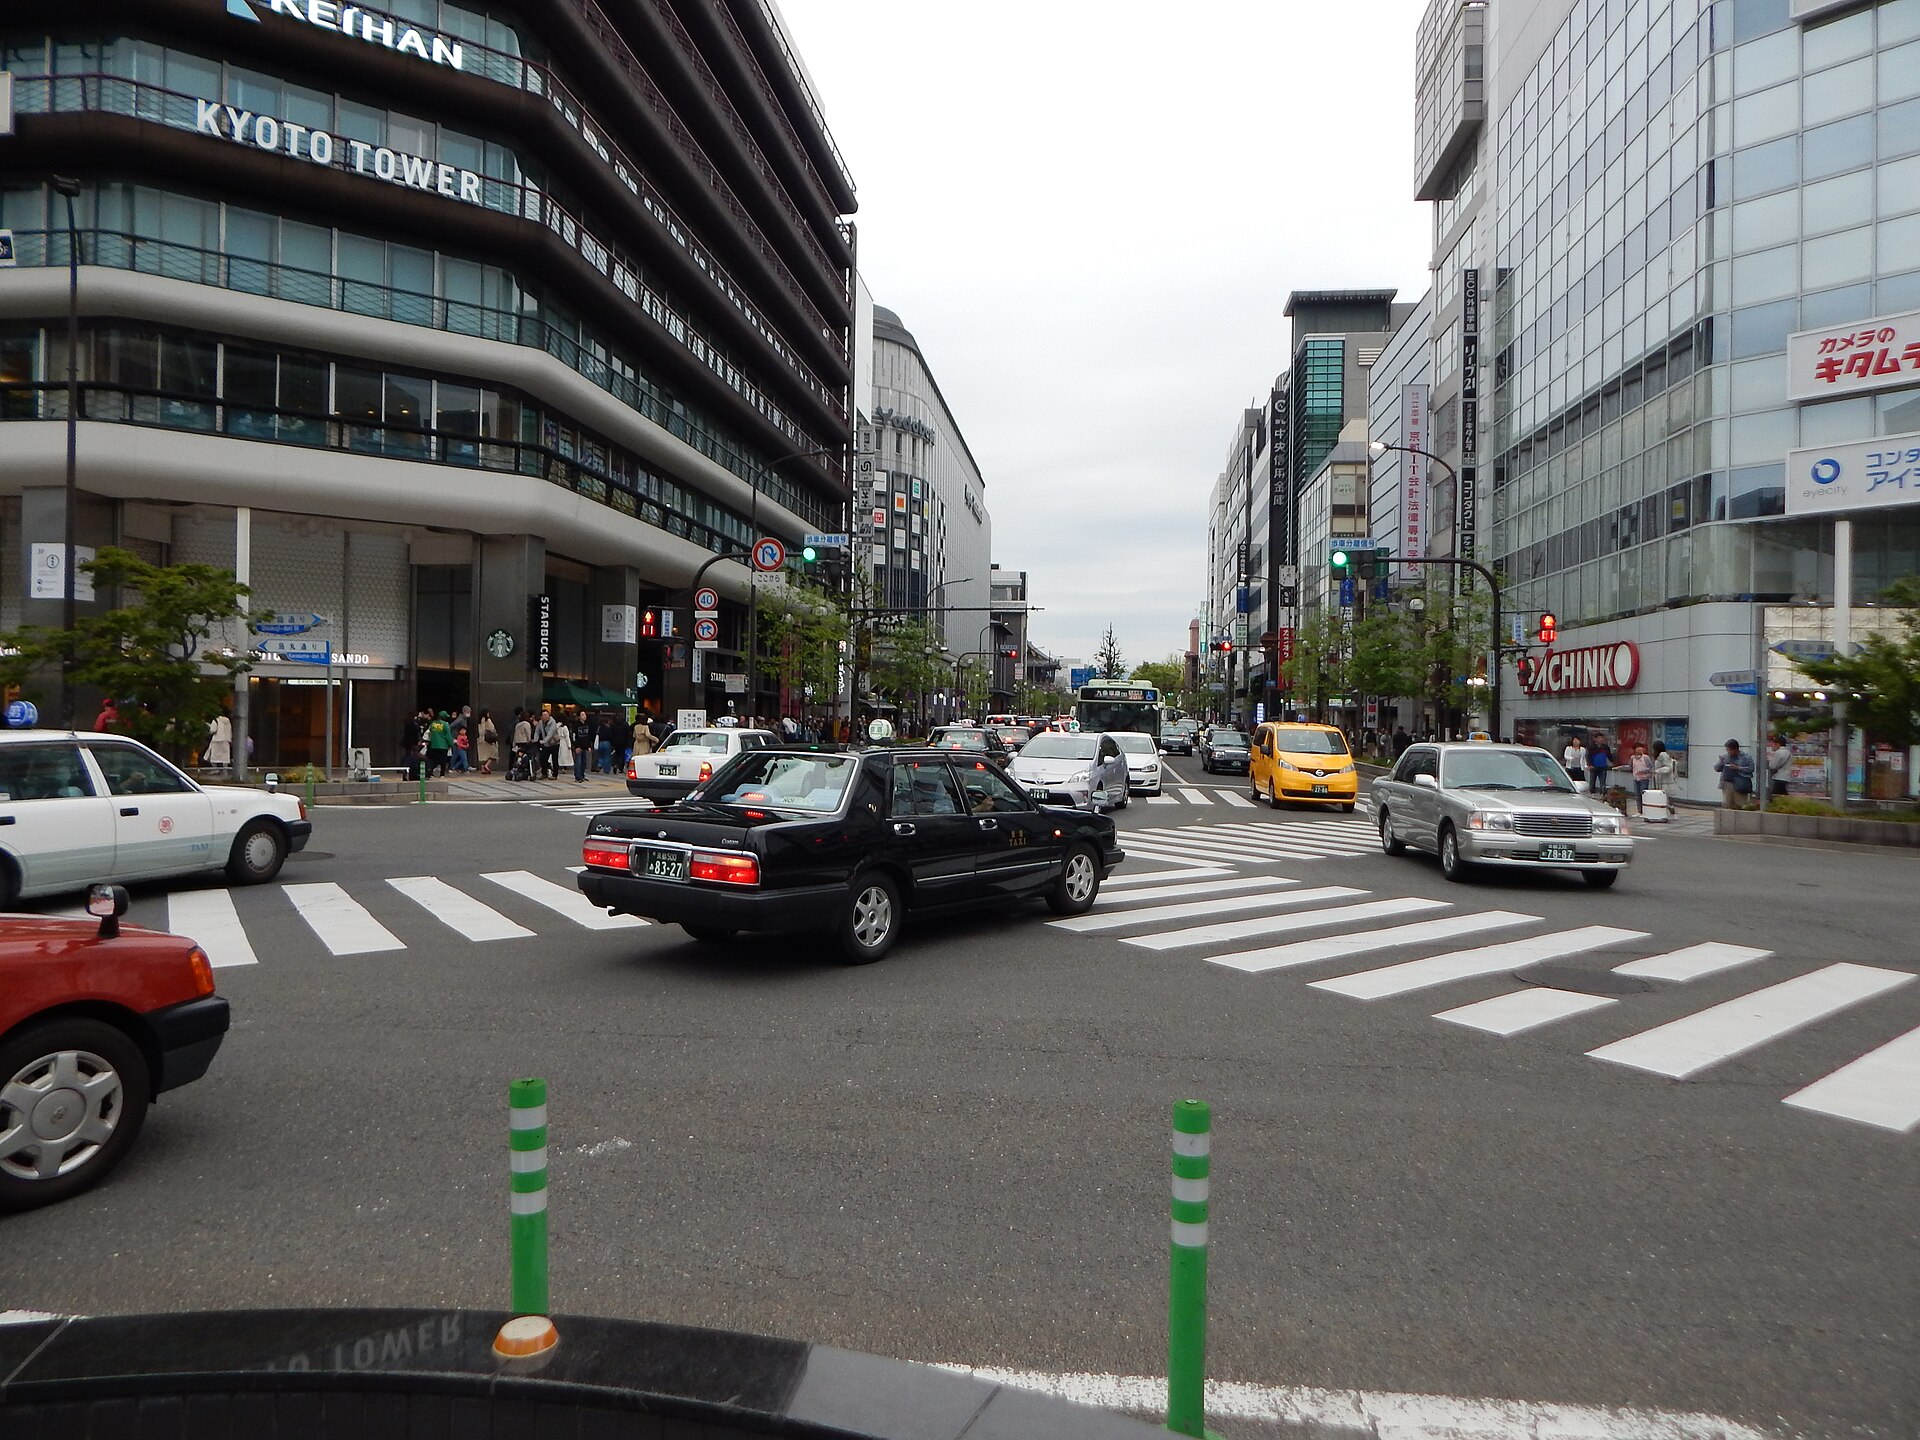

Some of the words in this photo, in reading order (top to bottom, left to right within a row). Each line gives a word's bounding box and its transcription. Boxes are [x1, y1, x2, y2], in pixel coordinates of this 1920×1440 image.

[197, 99, 333, 164] KYOTO
[350, 139, 483, 203] TOWER
[1817, 326, 1896, 355] カメラの
[1464, 344, 1476, 391] リーブ21
[1803, 484, 1848, 499] eyecity
[1463, 480, 1473, 529] コンタクト
[757, 574, 780, 583] ここから
[701, 595, 713, 605] 40
[540, 596, 549, 669] STARBUCKS
[331, 654, 369, 664] SANDO
[1009, 838, 1026, 846] TAXI
